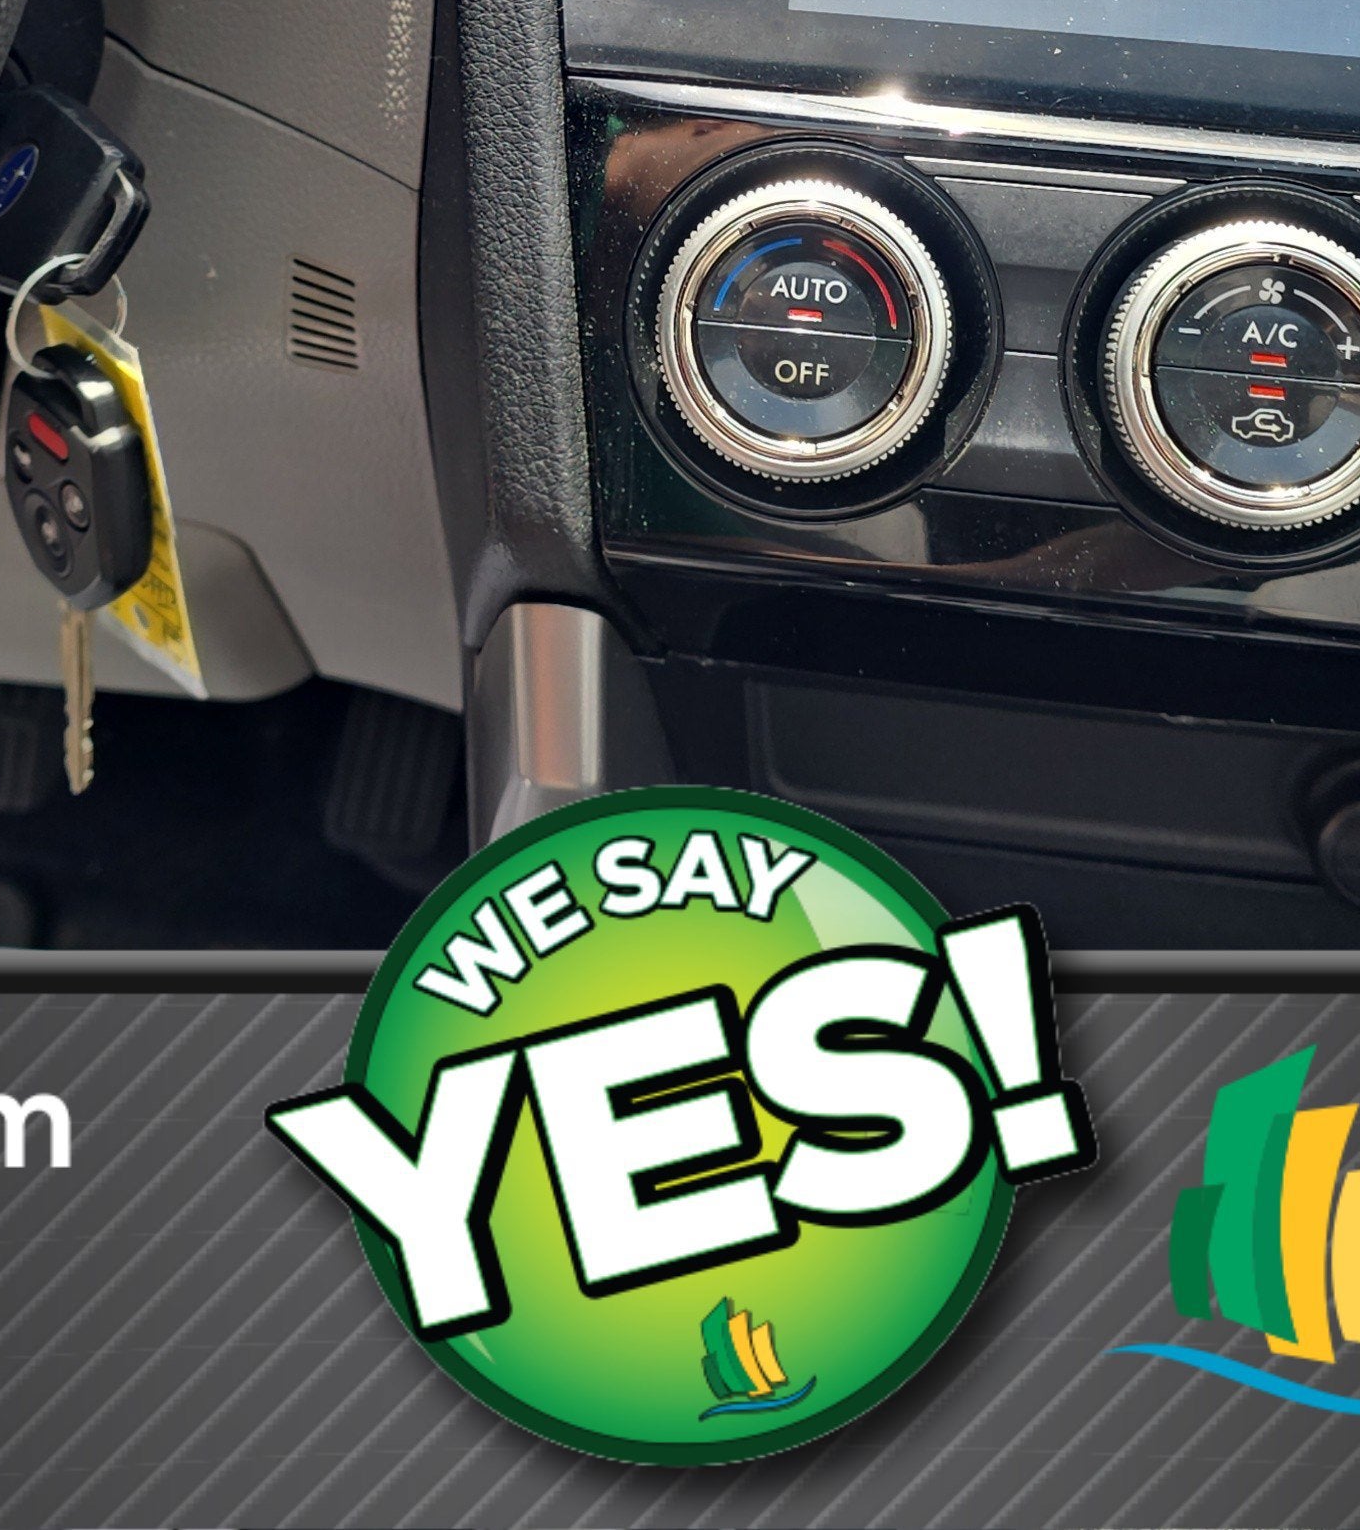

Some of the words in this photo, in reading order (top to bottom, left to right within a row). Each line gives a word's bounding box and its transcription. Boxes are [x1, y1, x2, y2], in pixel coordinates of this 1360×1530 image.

[771, 274, 848, 305] AUTO
[1242, 320, 1299, 349] A/C
[774, 358, 829, 385] OFF
